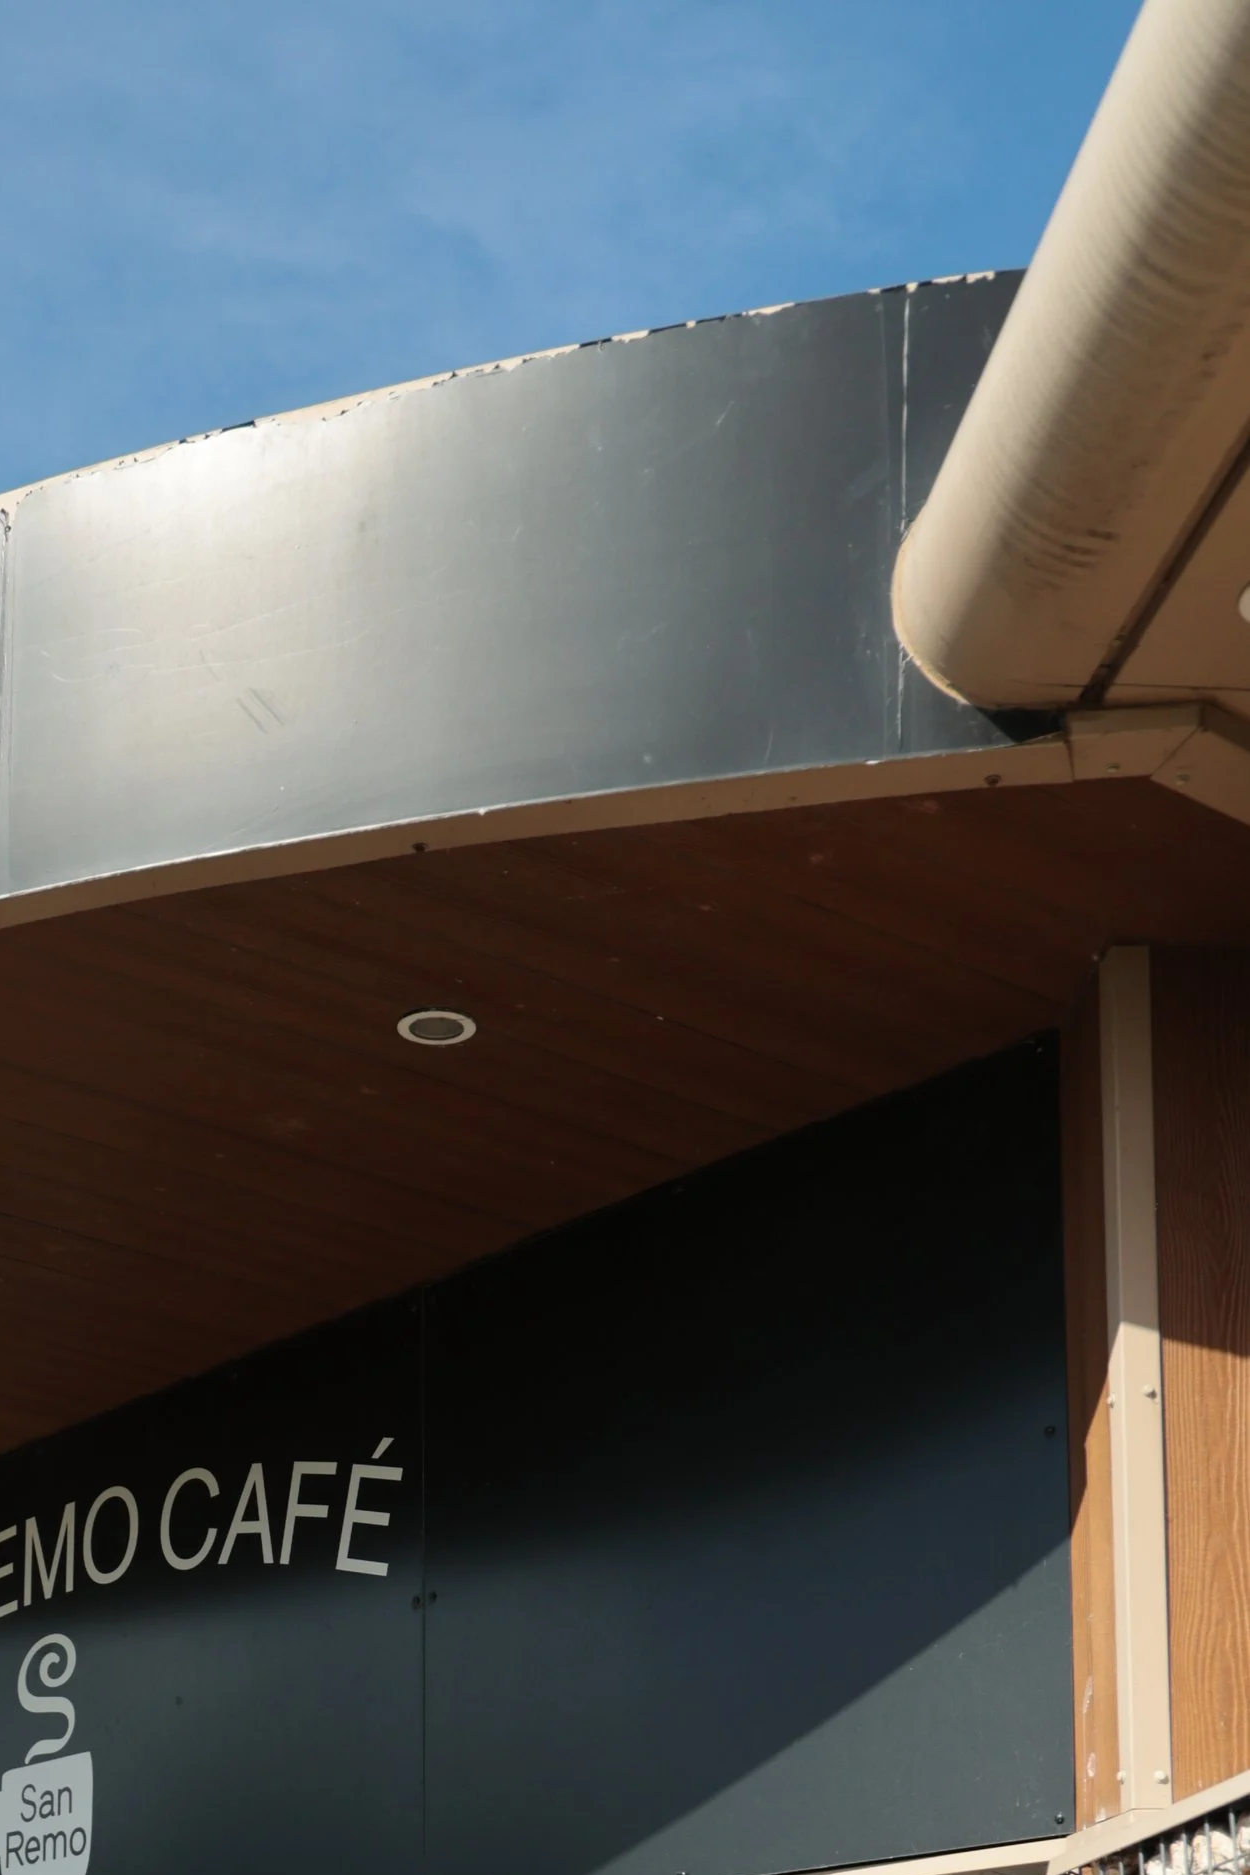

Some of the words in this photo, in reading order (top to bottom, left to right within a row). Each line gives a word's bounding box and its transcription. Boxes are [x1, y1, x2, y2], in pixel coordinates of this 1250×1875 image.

[158, 1437, 403, 1577] CAFÉ
[19, 1782, 74, 1823] San
[4, 1823, 88, 1869] Remo
